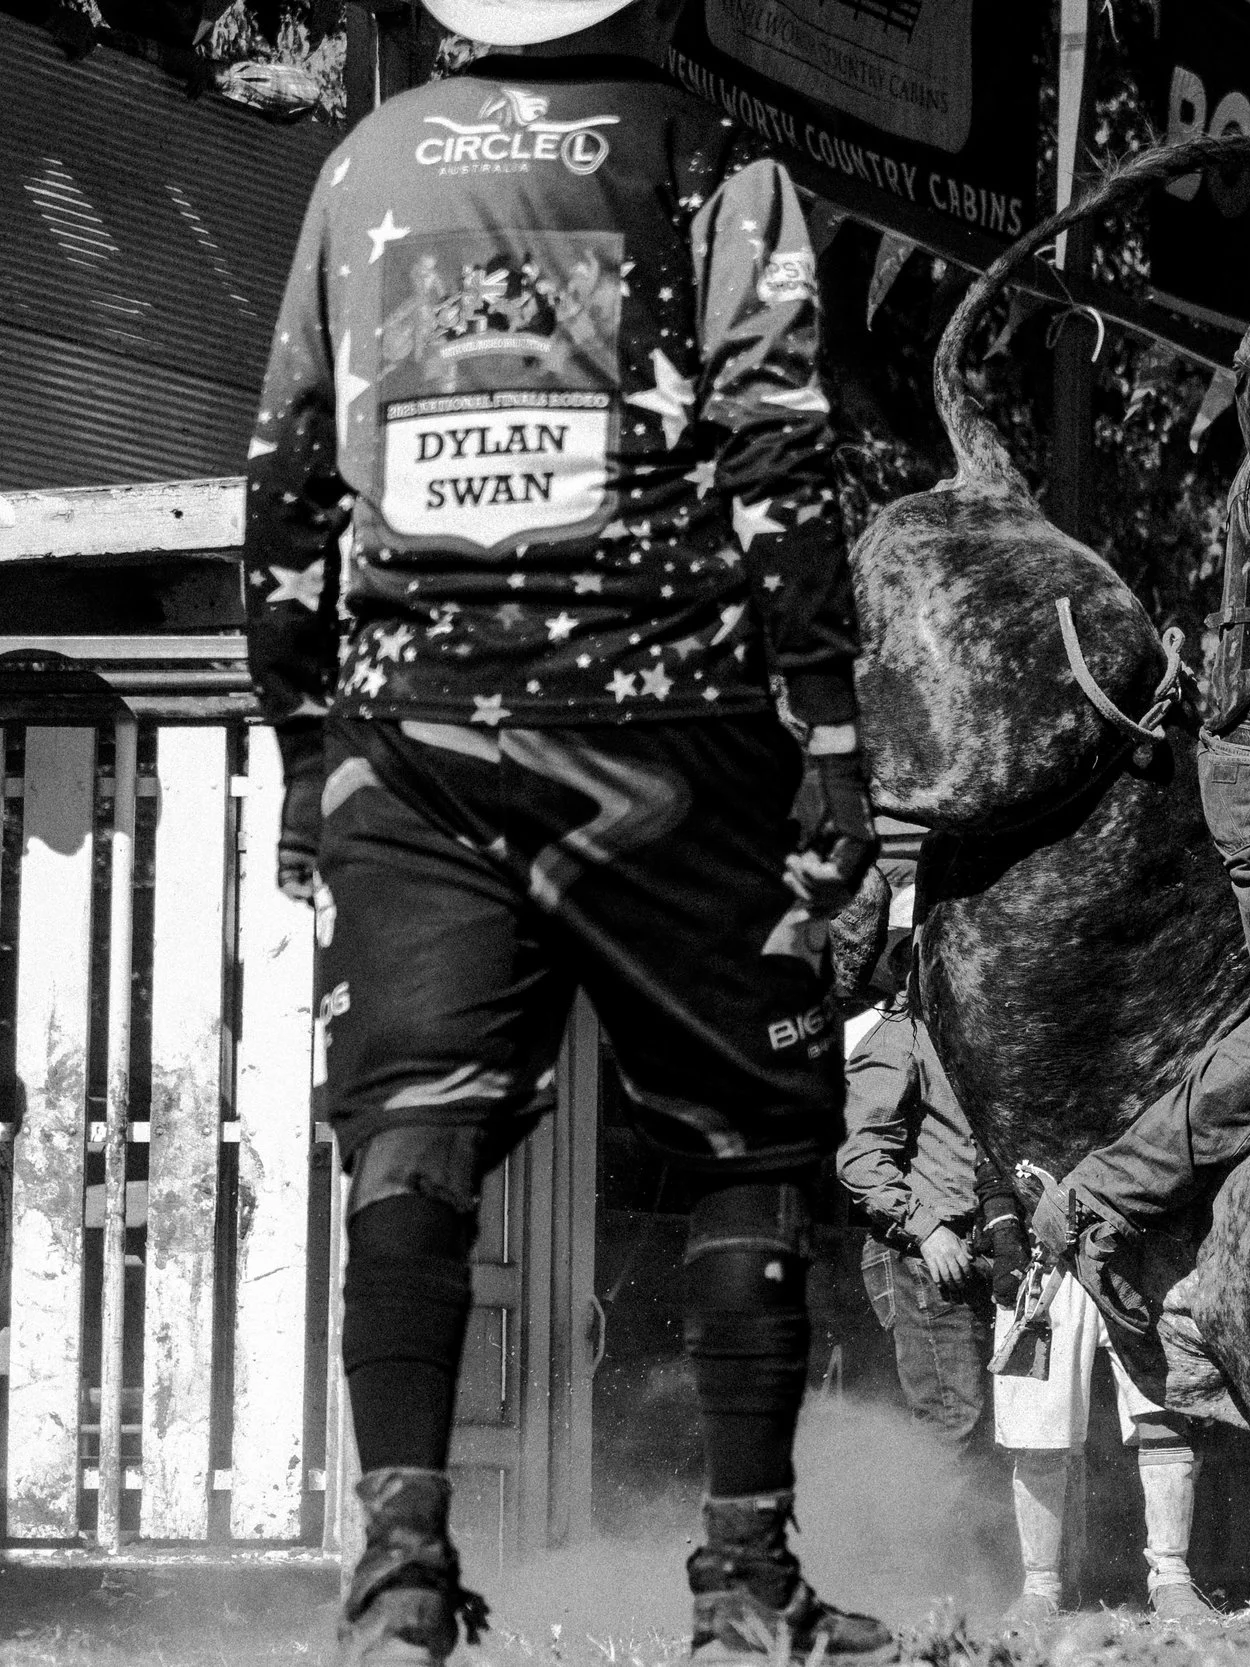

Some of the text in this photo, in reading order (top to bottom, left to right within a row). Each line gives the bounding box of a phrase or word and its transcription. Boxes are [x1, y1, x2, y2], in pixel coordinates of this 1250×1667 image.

[415, 134, 561, 165] CIRCLE
[438, 162, 530, 176] AUSTRALIA
[804, 124, 918, 202] COUNTRY
[928, 173, 1023, 237] CABINS
[415, 424, 569, 464] DYLAN
[426, 472, 555, 511] SWAN
[768, 1005, 824, 1051] BIG
